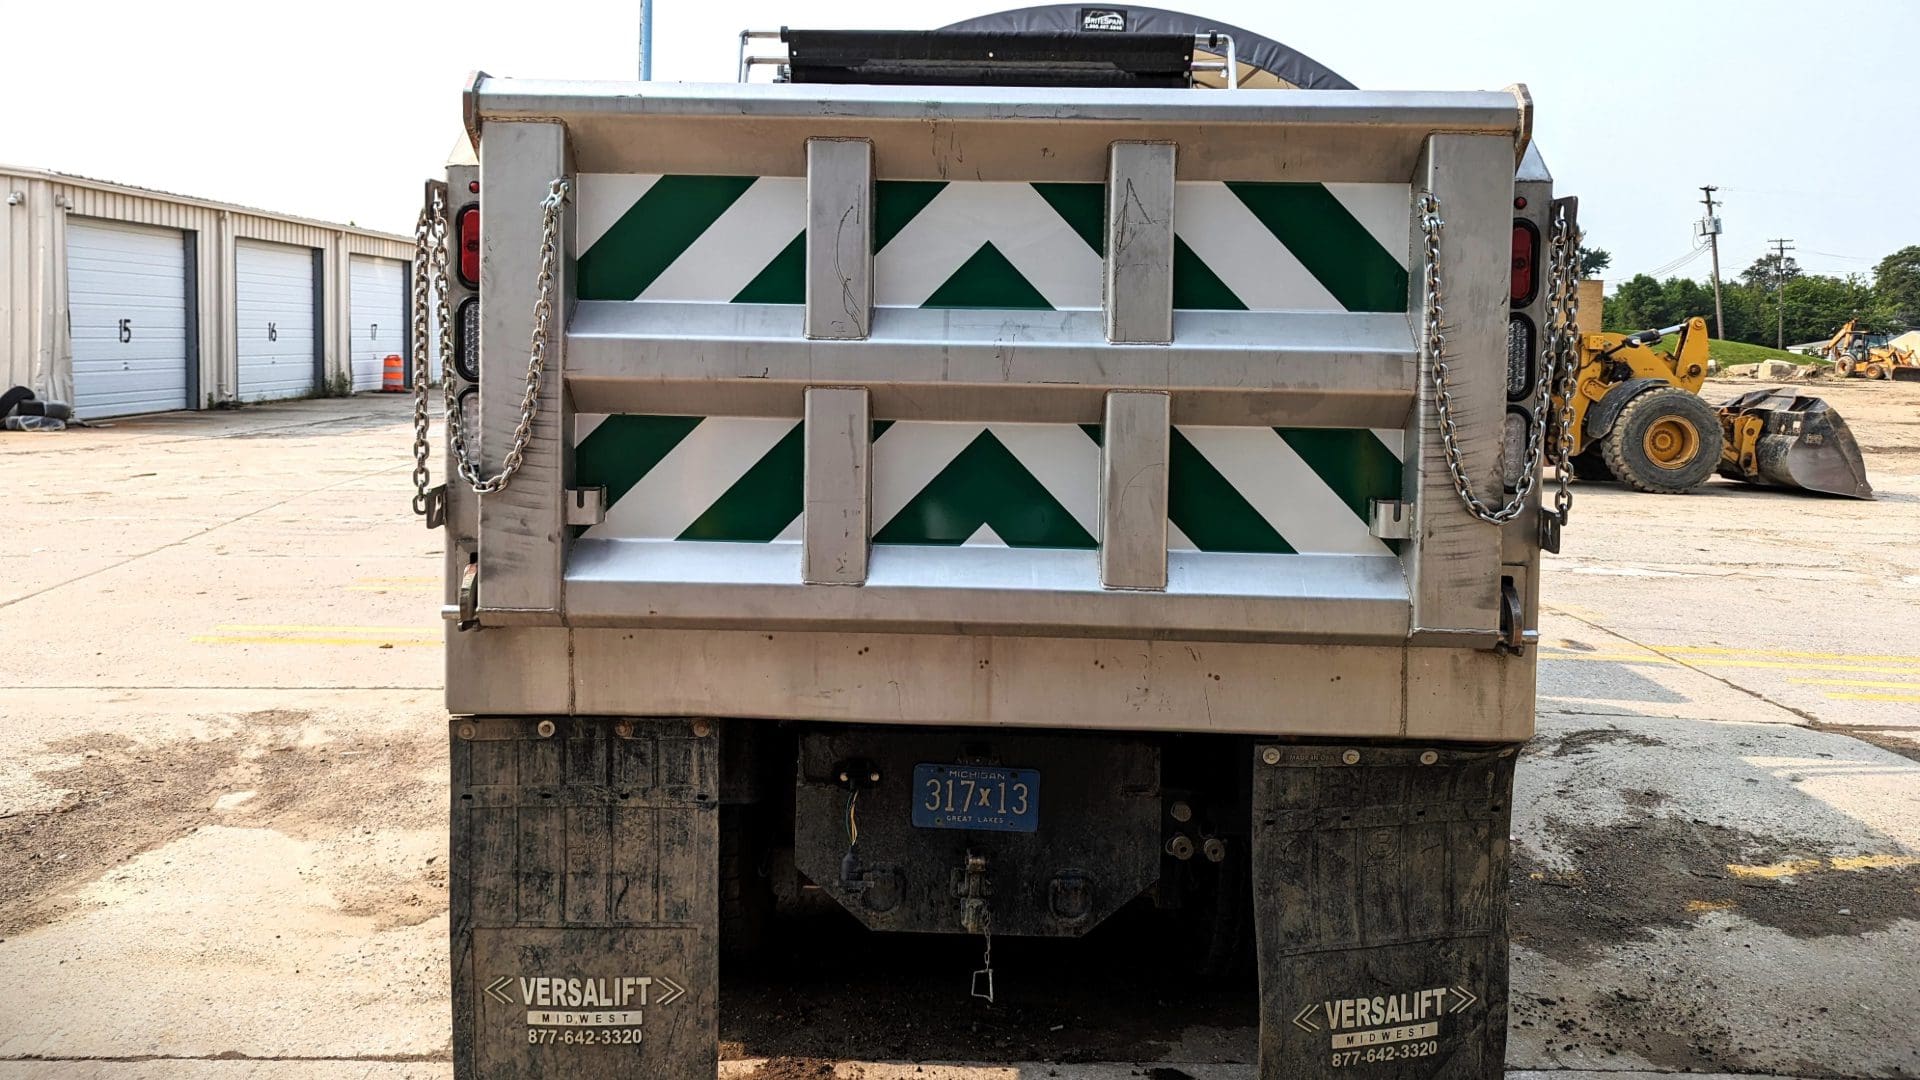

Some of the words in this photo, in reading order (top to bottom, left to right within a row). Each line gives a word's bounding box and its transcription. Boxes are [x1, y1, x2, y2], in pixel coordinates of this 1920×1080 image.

[118, 319, 132, 343] 15
[268, 322, 278, 342] 16
[370, 323, 378, 341] 17
[949, 770, 1006, 780] MICHIGAN
[519, 976, 652, 1007] VERSALIFT
[541, 1013, 630, 1023] MIDWEST
[1324, 987, 1447, 1030] VERSALIFT
[528, 1029, 643, 1045] 877-642-3320
[1346, 1026, 1426, 1045] MIDWEST
[1331, 1040, 1438, 1068] 877-642-3320
